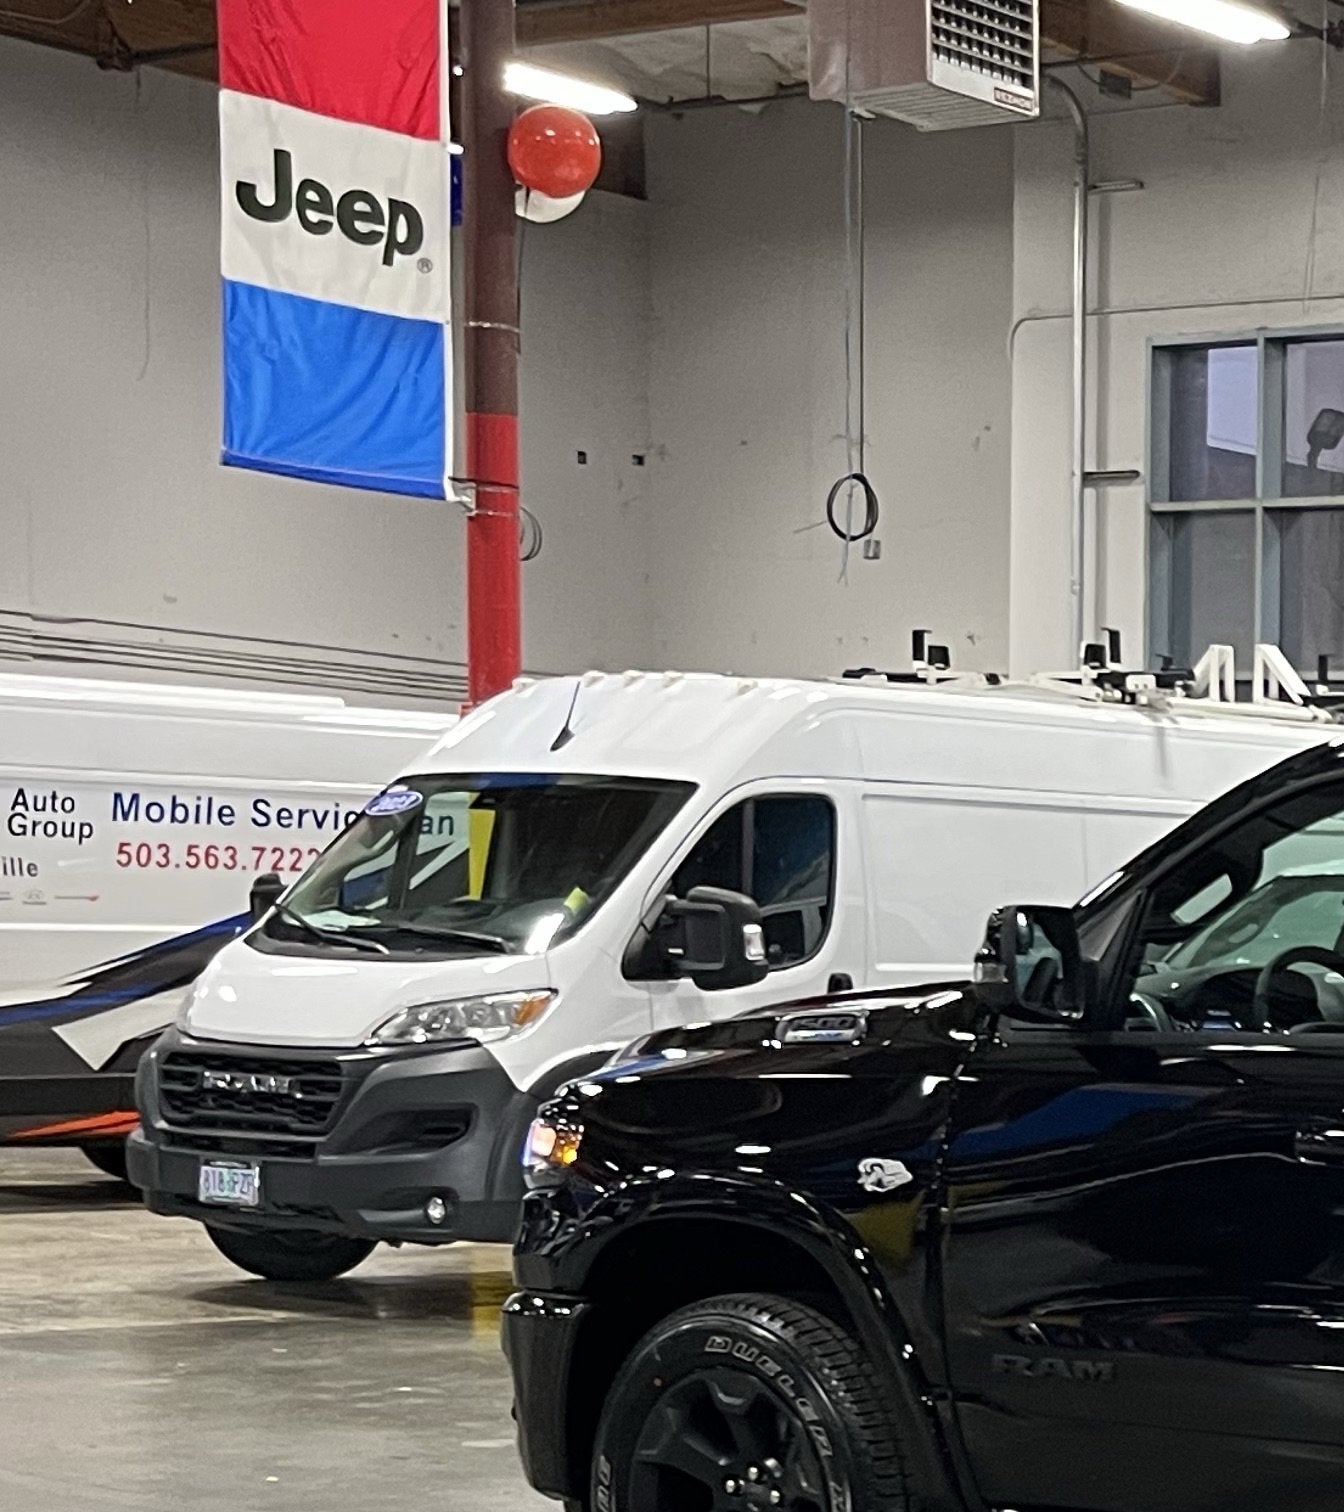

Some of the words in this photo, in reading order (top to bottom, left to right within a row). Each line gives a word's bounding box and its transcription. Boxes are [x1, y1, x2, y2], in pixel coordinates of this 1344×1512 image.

[235, 148, 424, 267] Jeep
[10, 788, 75, 814] Auto
[111, 791, 236, 827] Mobile
[250, 798, 364, 831] Servic
[419, 814, 454, 836] an
[7, 812, 94, 845] Group
[992, 1353, 1115, 1381] RAM
